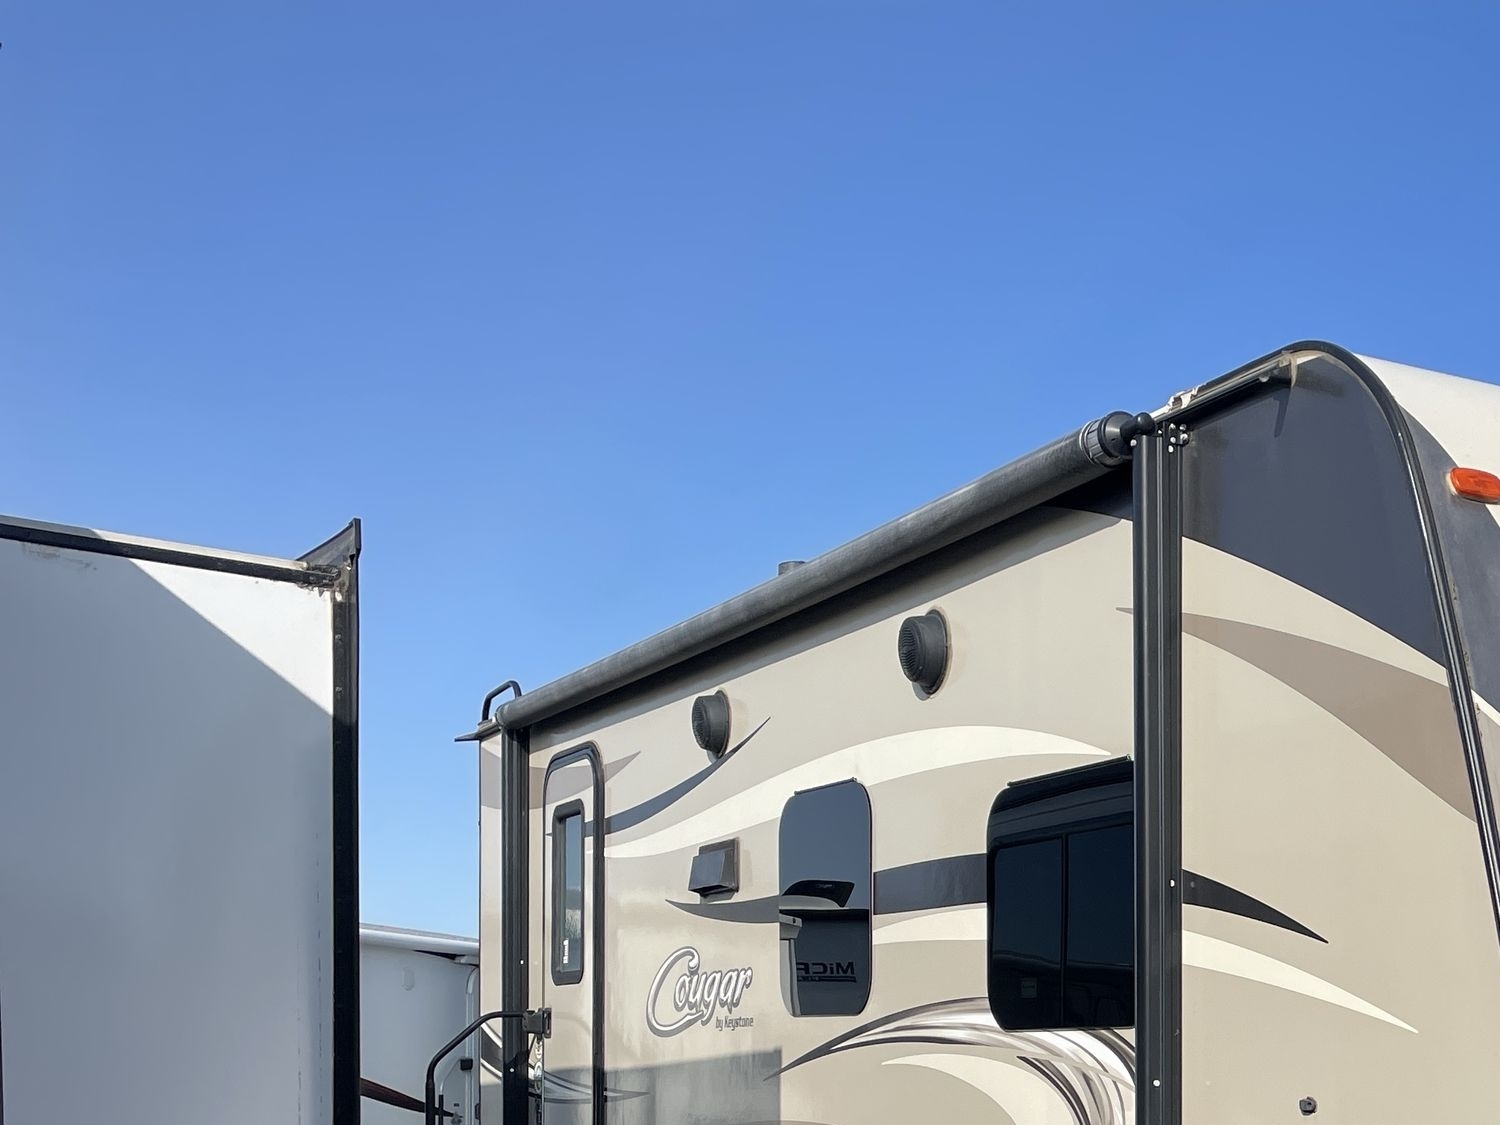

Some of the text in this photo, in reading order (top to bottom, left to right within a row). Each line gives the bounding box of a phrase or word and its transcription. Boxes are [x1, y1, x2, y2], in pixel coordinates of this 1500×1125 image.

[646, 946, 753, 1038] Cougar
[715, 1015, 754, 1032] by Keystone
